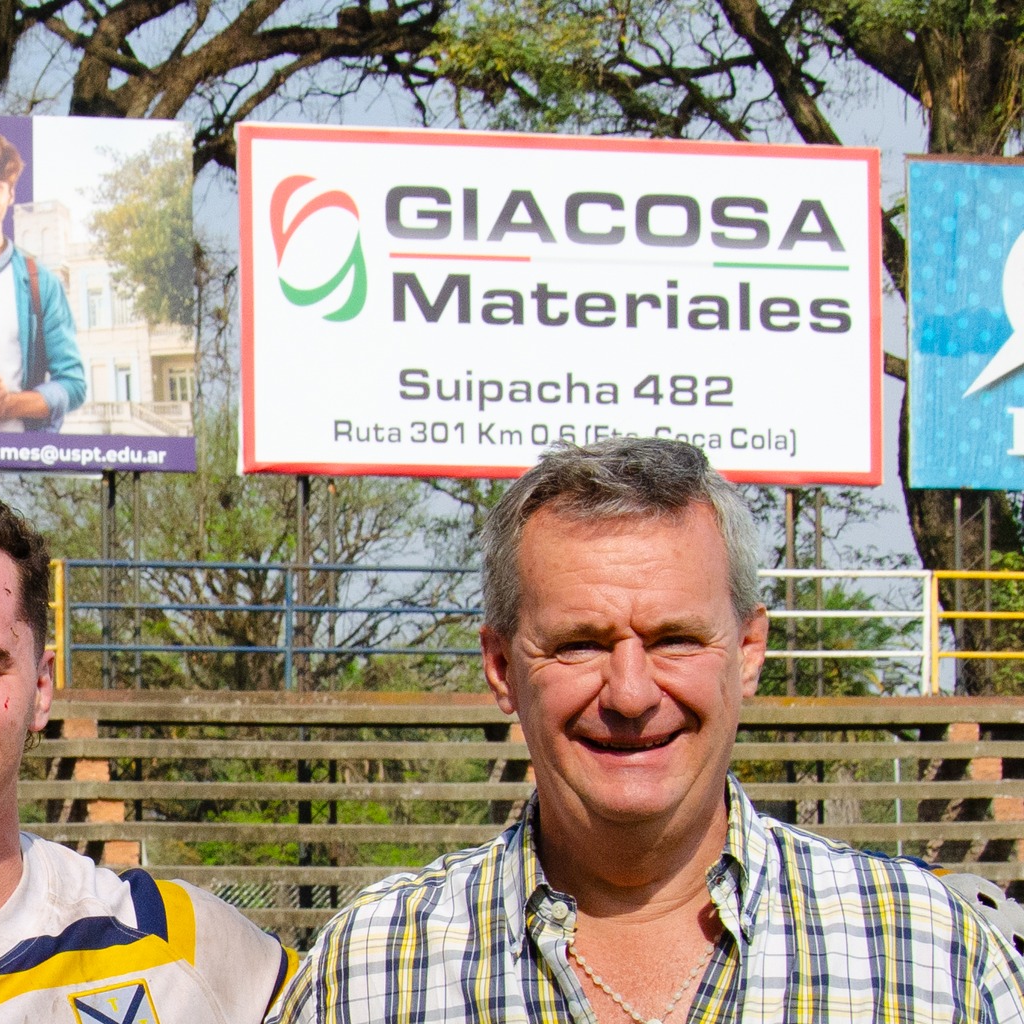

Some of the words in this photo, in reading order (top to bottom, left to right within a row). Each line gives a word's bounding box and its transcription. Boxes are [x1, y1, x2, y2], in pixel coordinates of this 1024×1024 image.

[384, 185, 846, 252] GIACOSA
[391, 272, 852, 334] Materiales
[398, 368, 619, 412] Suipacha
[633, 374, 734, 407] 482
[333, 420, 402, 443] Ruta
[410, 422, 466, 445] 301
[478, 423, 523, 446] Km
[730, 428, 797, 457] Cola)
